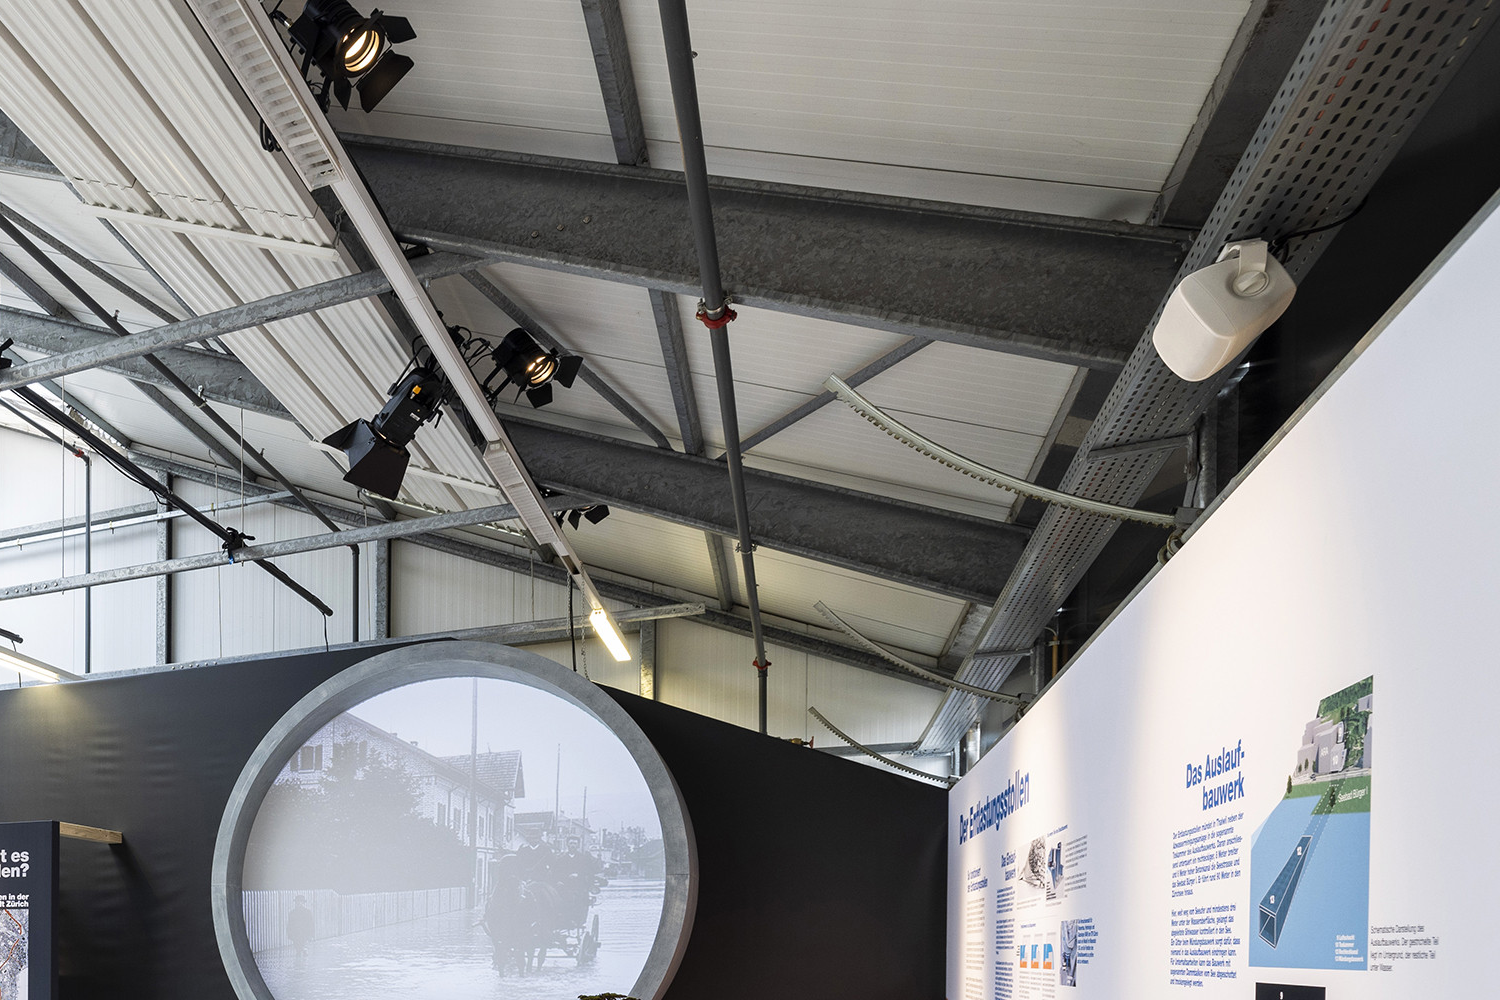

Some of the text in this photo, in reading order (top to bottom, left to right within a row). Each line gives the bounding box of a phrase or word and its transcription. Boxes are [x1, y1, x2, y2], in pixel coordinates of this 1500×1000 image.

[1186, 739, 1245, 788] Das Auslauf-
[1202, 771, 1245, 811] bauwerk
[10, 851, 30, 862] es
[6, 900, 29, 908] Zürich
